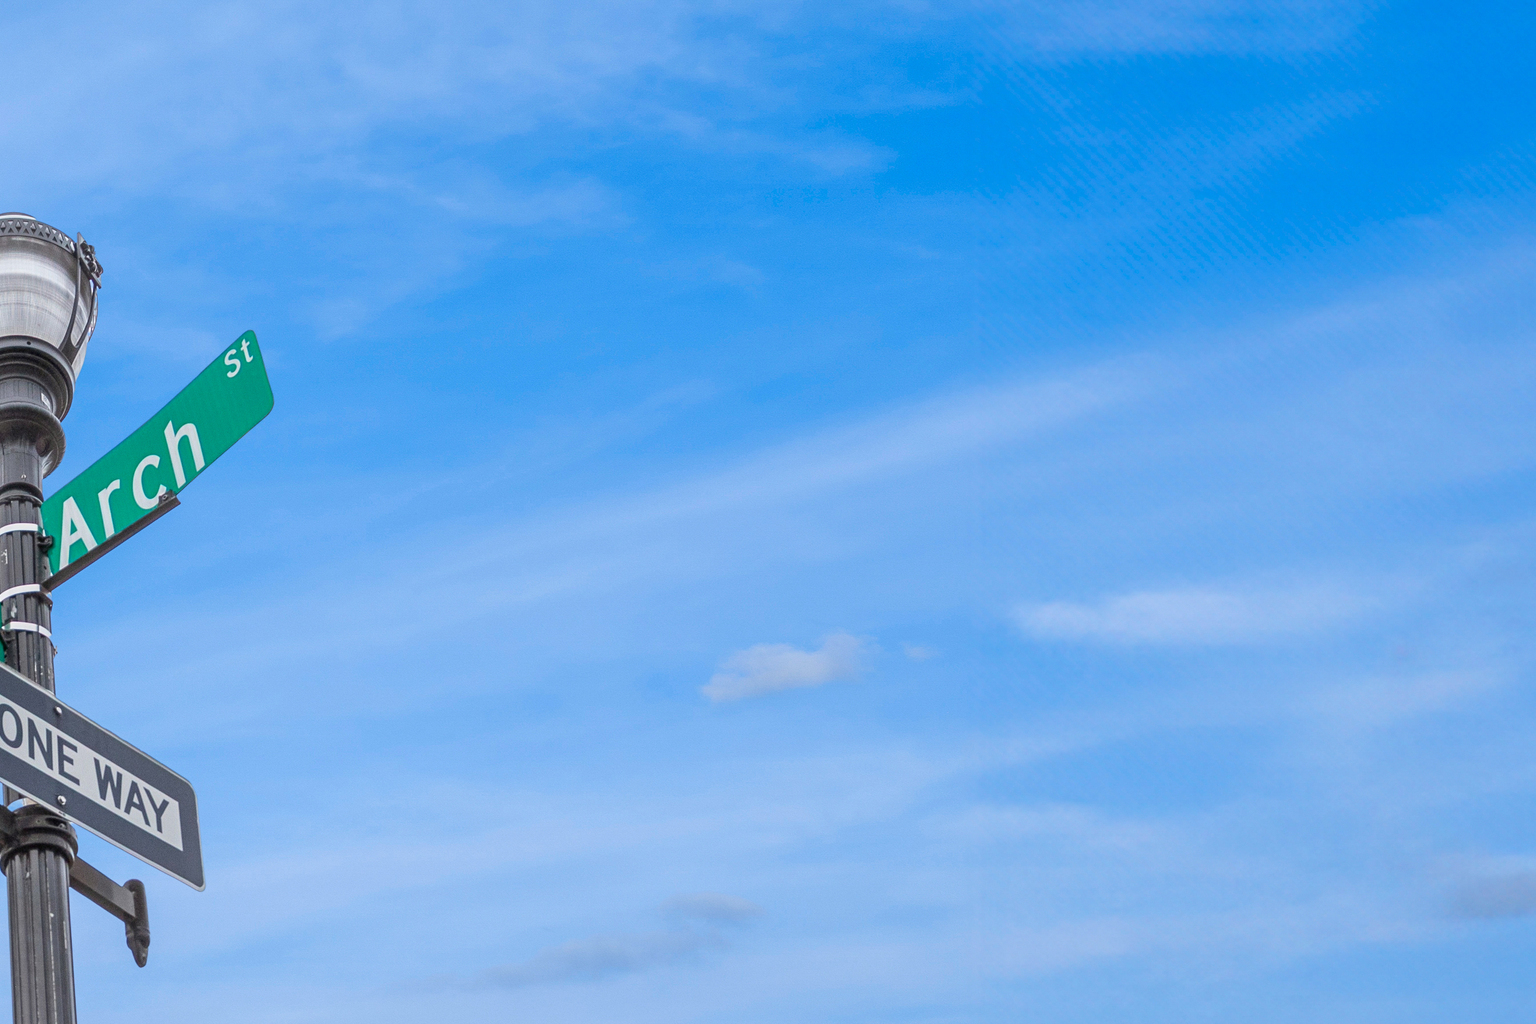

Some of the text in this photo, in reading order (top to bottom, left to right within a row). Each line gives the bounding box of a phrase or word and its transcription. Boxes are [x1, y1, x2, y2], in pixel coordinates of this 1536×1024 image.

[59, 338, 254, 570] Arch St
[93, 757, 169, 834] WAY
